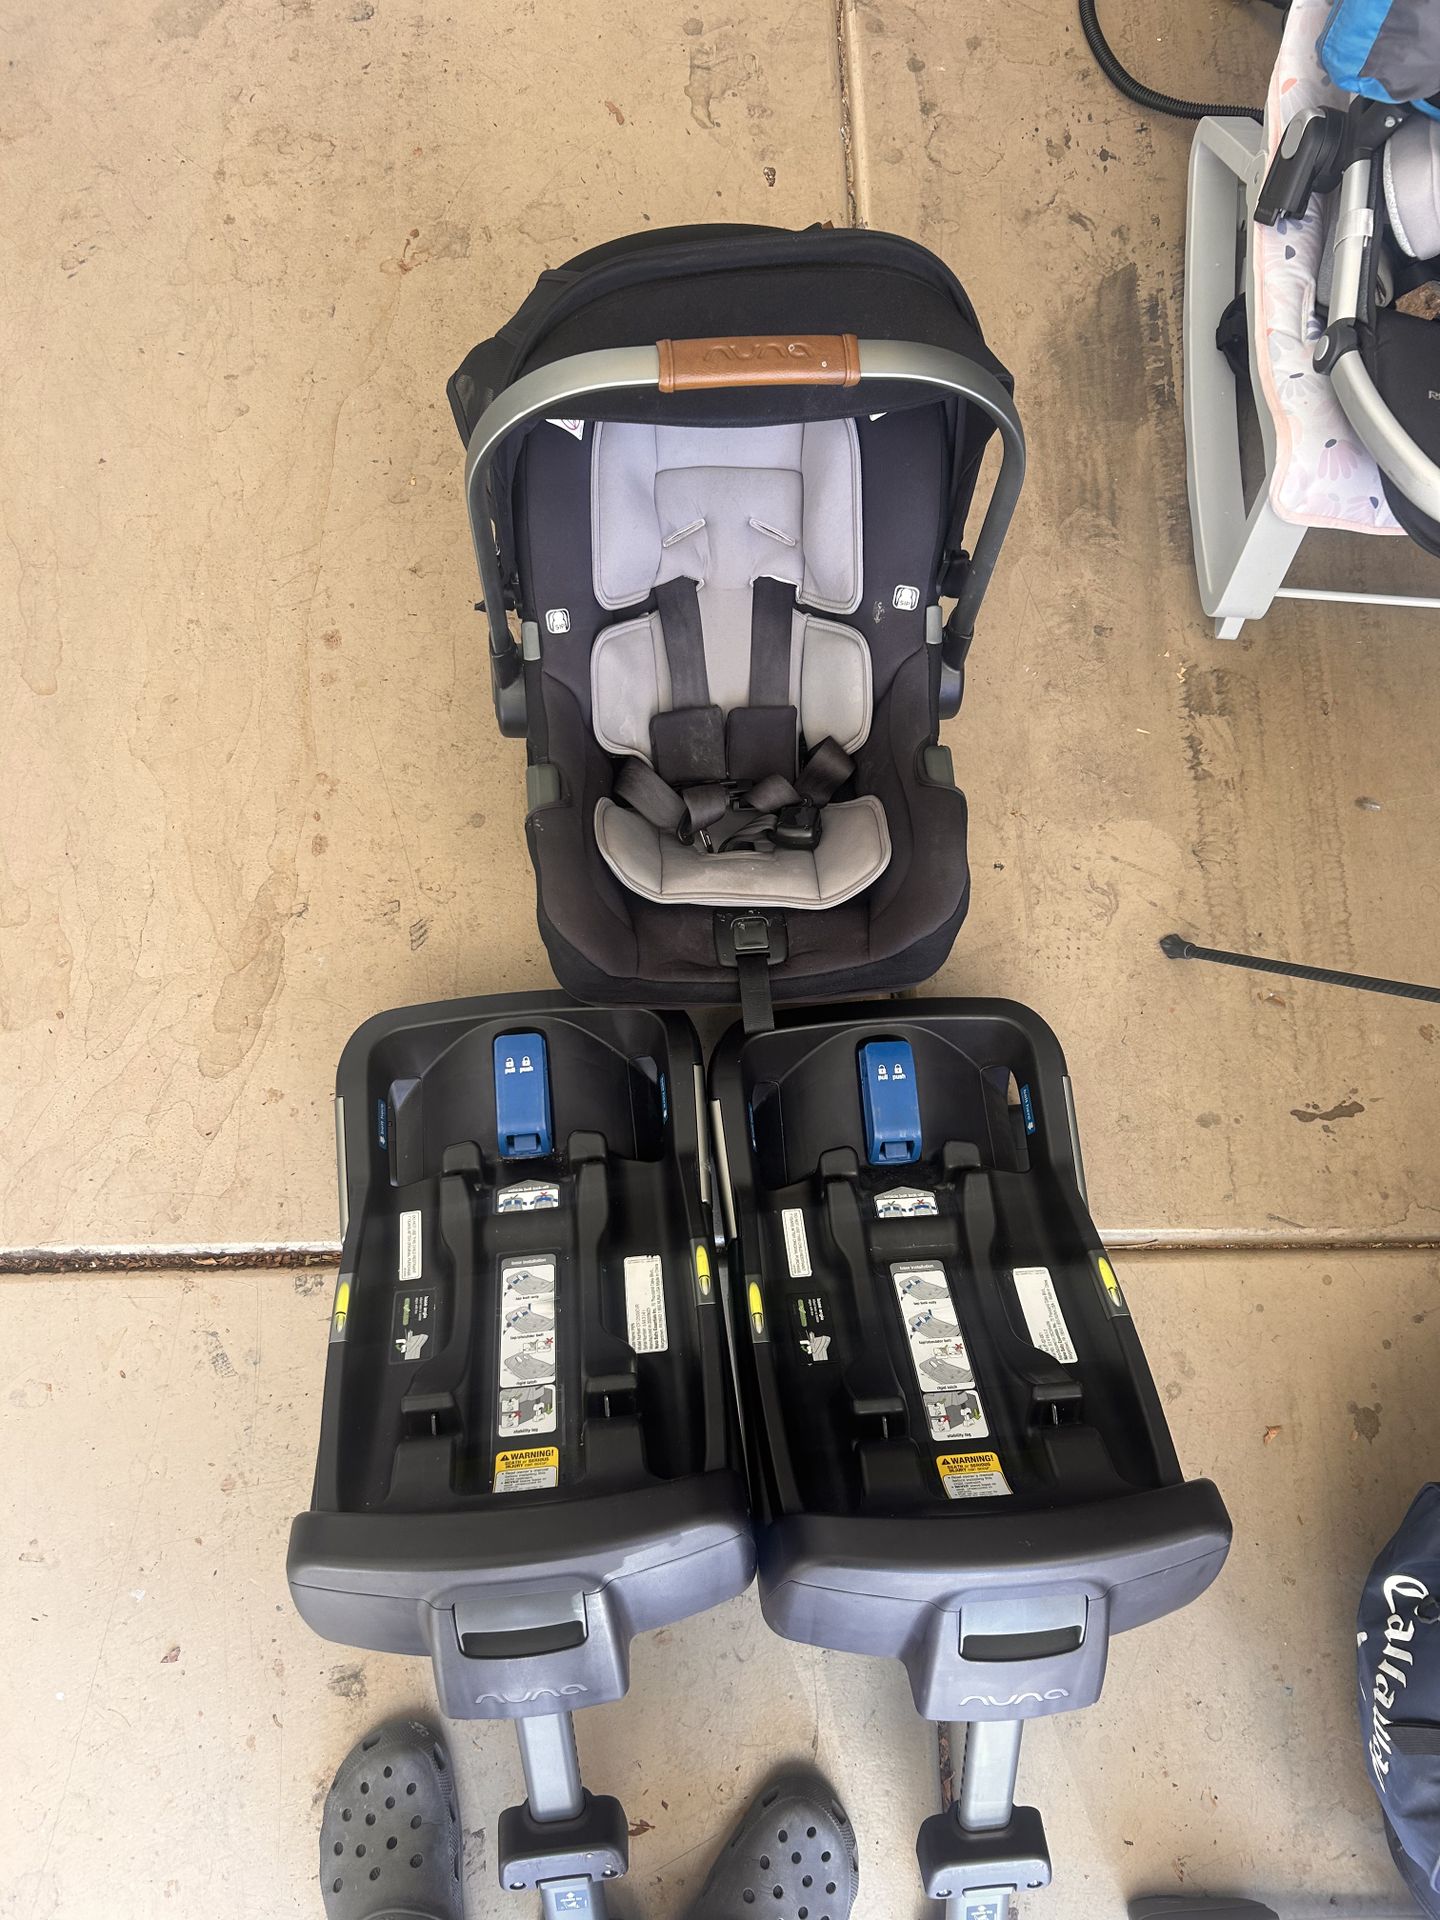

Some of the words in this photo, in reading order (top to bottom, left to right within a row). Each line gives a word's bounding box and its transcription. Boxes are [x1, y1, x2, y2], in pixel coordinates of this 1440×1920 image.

[511, 1450, 554, 1460] WARNING!
[950, 1454, 994, 1464] WARNING!
[475, 1684, 588, 1704] nuna
[959, 1688, 1069, 1706] nuna
